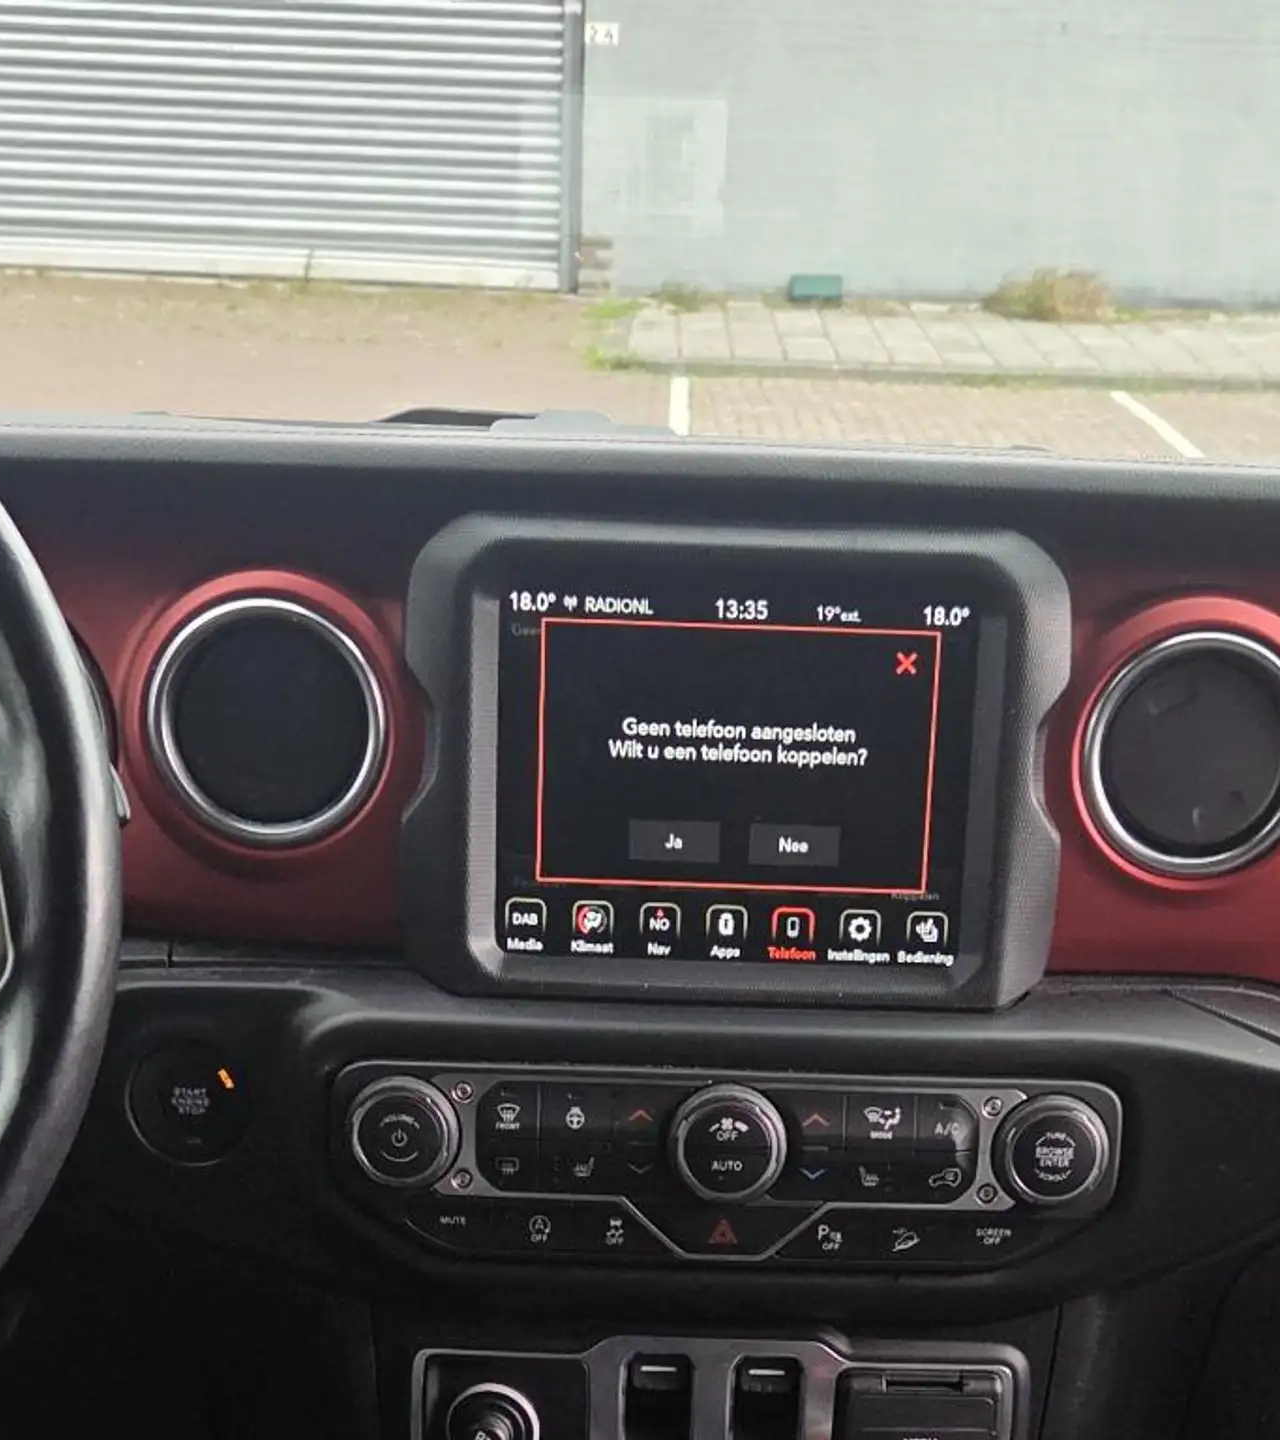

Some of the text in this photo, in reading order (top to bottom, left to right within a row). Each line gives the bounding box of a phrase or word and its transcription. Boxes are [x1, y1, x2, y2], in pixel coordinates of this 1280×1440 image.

[584, 596, 653, 615] RADIONL
[715, 598, 768, 620] 13:35
[622, 717, 856, 745] Geen telefoon aangesloten
[608, 739, 868, 768] Wilt u een telefoon koppelen?
[665, 833, 683, 849] Ja
[778, 837, 809, 853] Nee
[512, 911, 538, 926] DAB
[649, 917, 670, 931] NO
[506, 936, 543, 951] Media
[570, 940, 614, 954] Klimaat
[647, 942, 671, 956] Nav
[710, 944, 741, 960] Apps
[768, 946, 816, 961] Telefoon
[897, 950, 954, 967] Bediening
[716, 1131, 739, 1141] OFF
[934, 1122, 960, 1136] A/C
[711, 1160, 743, 1171] AUTO
[439, 1215, 466, 1225] MUTE
[976, 1228, 1012, 1237] SCREEN
